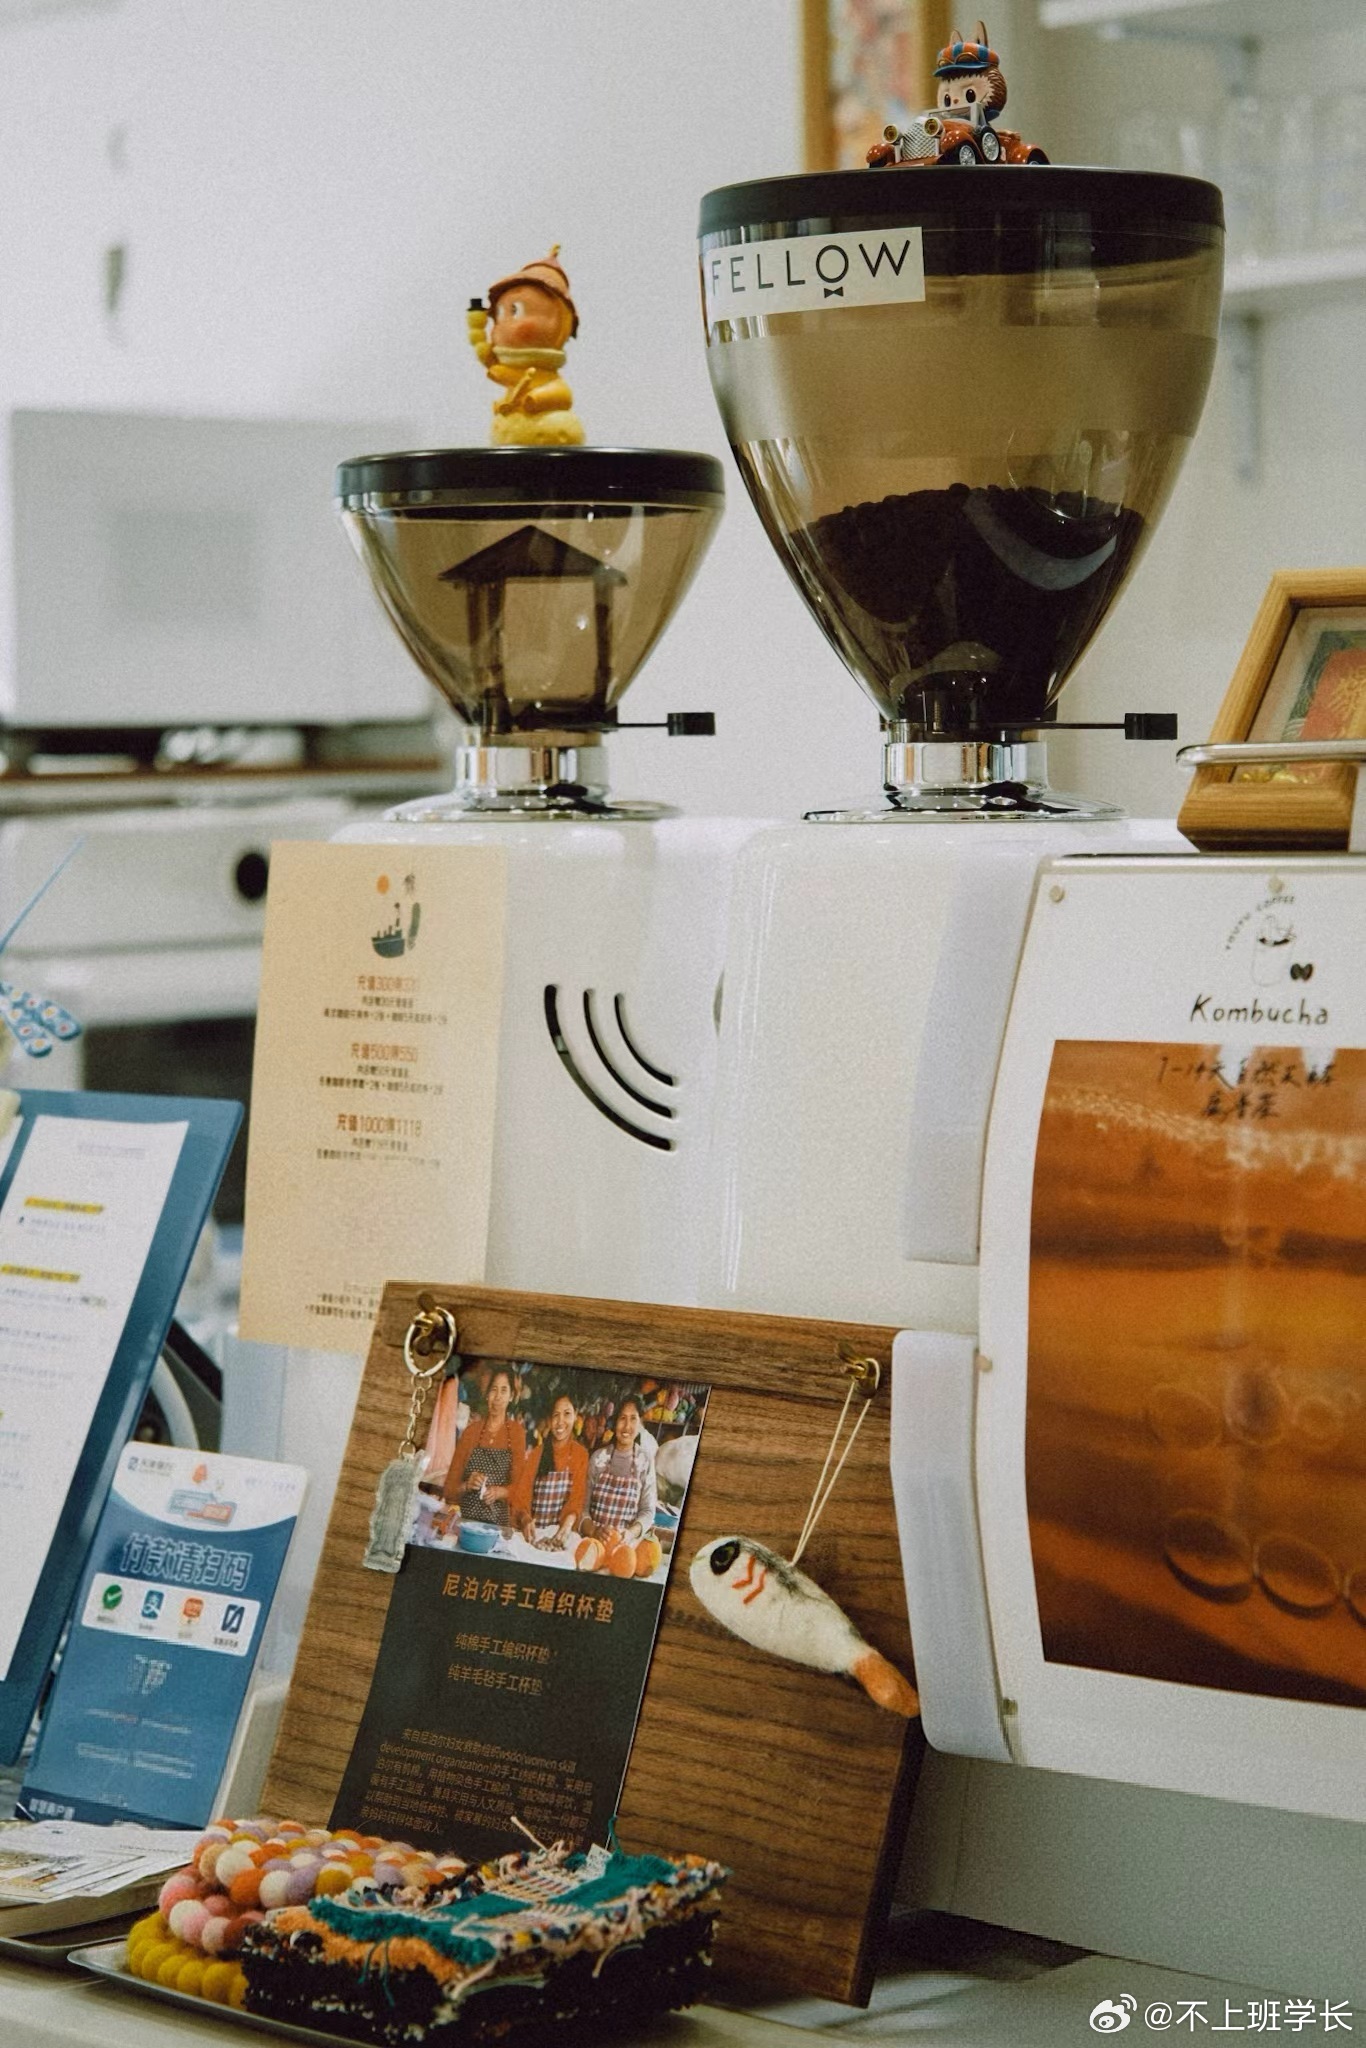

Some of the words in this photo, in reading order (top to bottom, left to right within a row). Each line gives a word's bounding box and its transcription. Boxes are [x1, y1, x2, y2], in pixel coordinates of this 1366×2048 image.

[711, 239, 911, 297] FELLOW
[1189, 993, 1329, 1026] Kombucha
[120, 1531, 254, 1592] 付款请扫码
[441, 1573, 615, 1625] 尼泊尔手工编织杯垫
[447, 1663, 544, 1697] 纯羊毛毡手工杯垫
